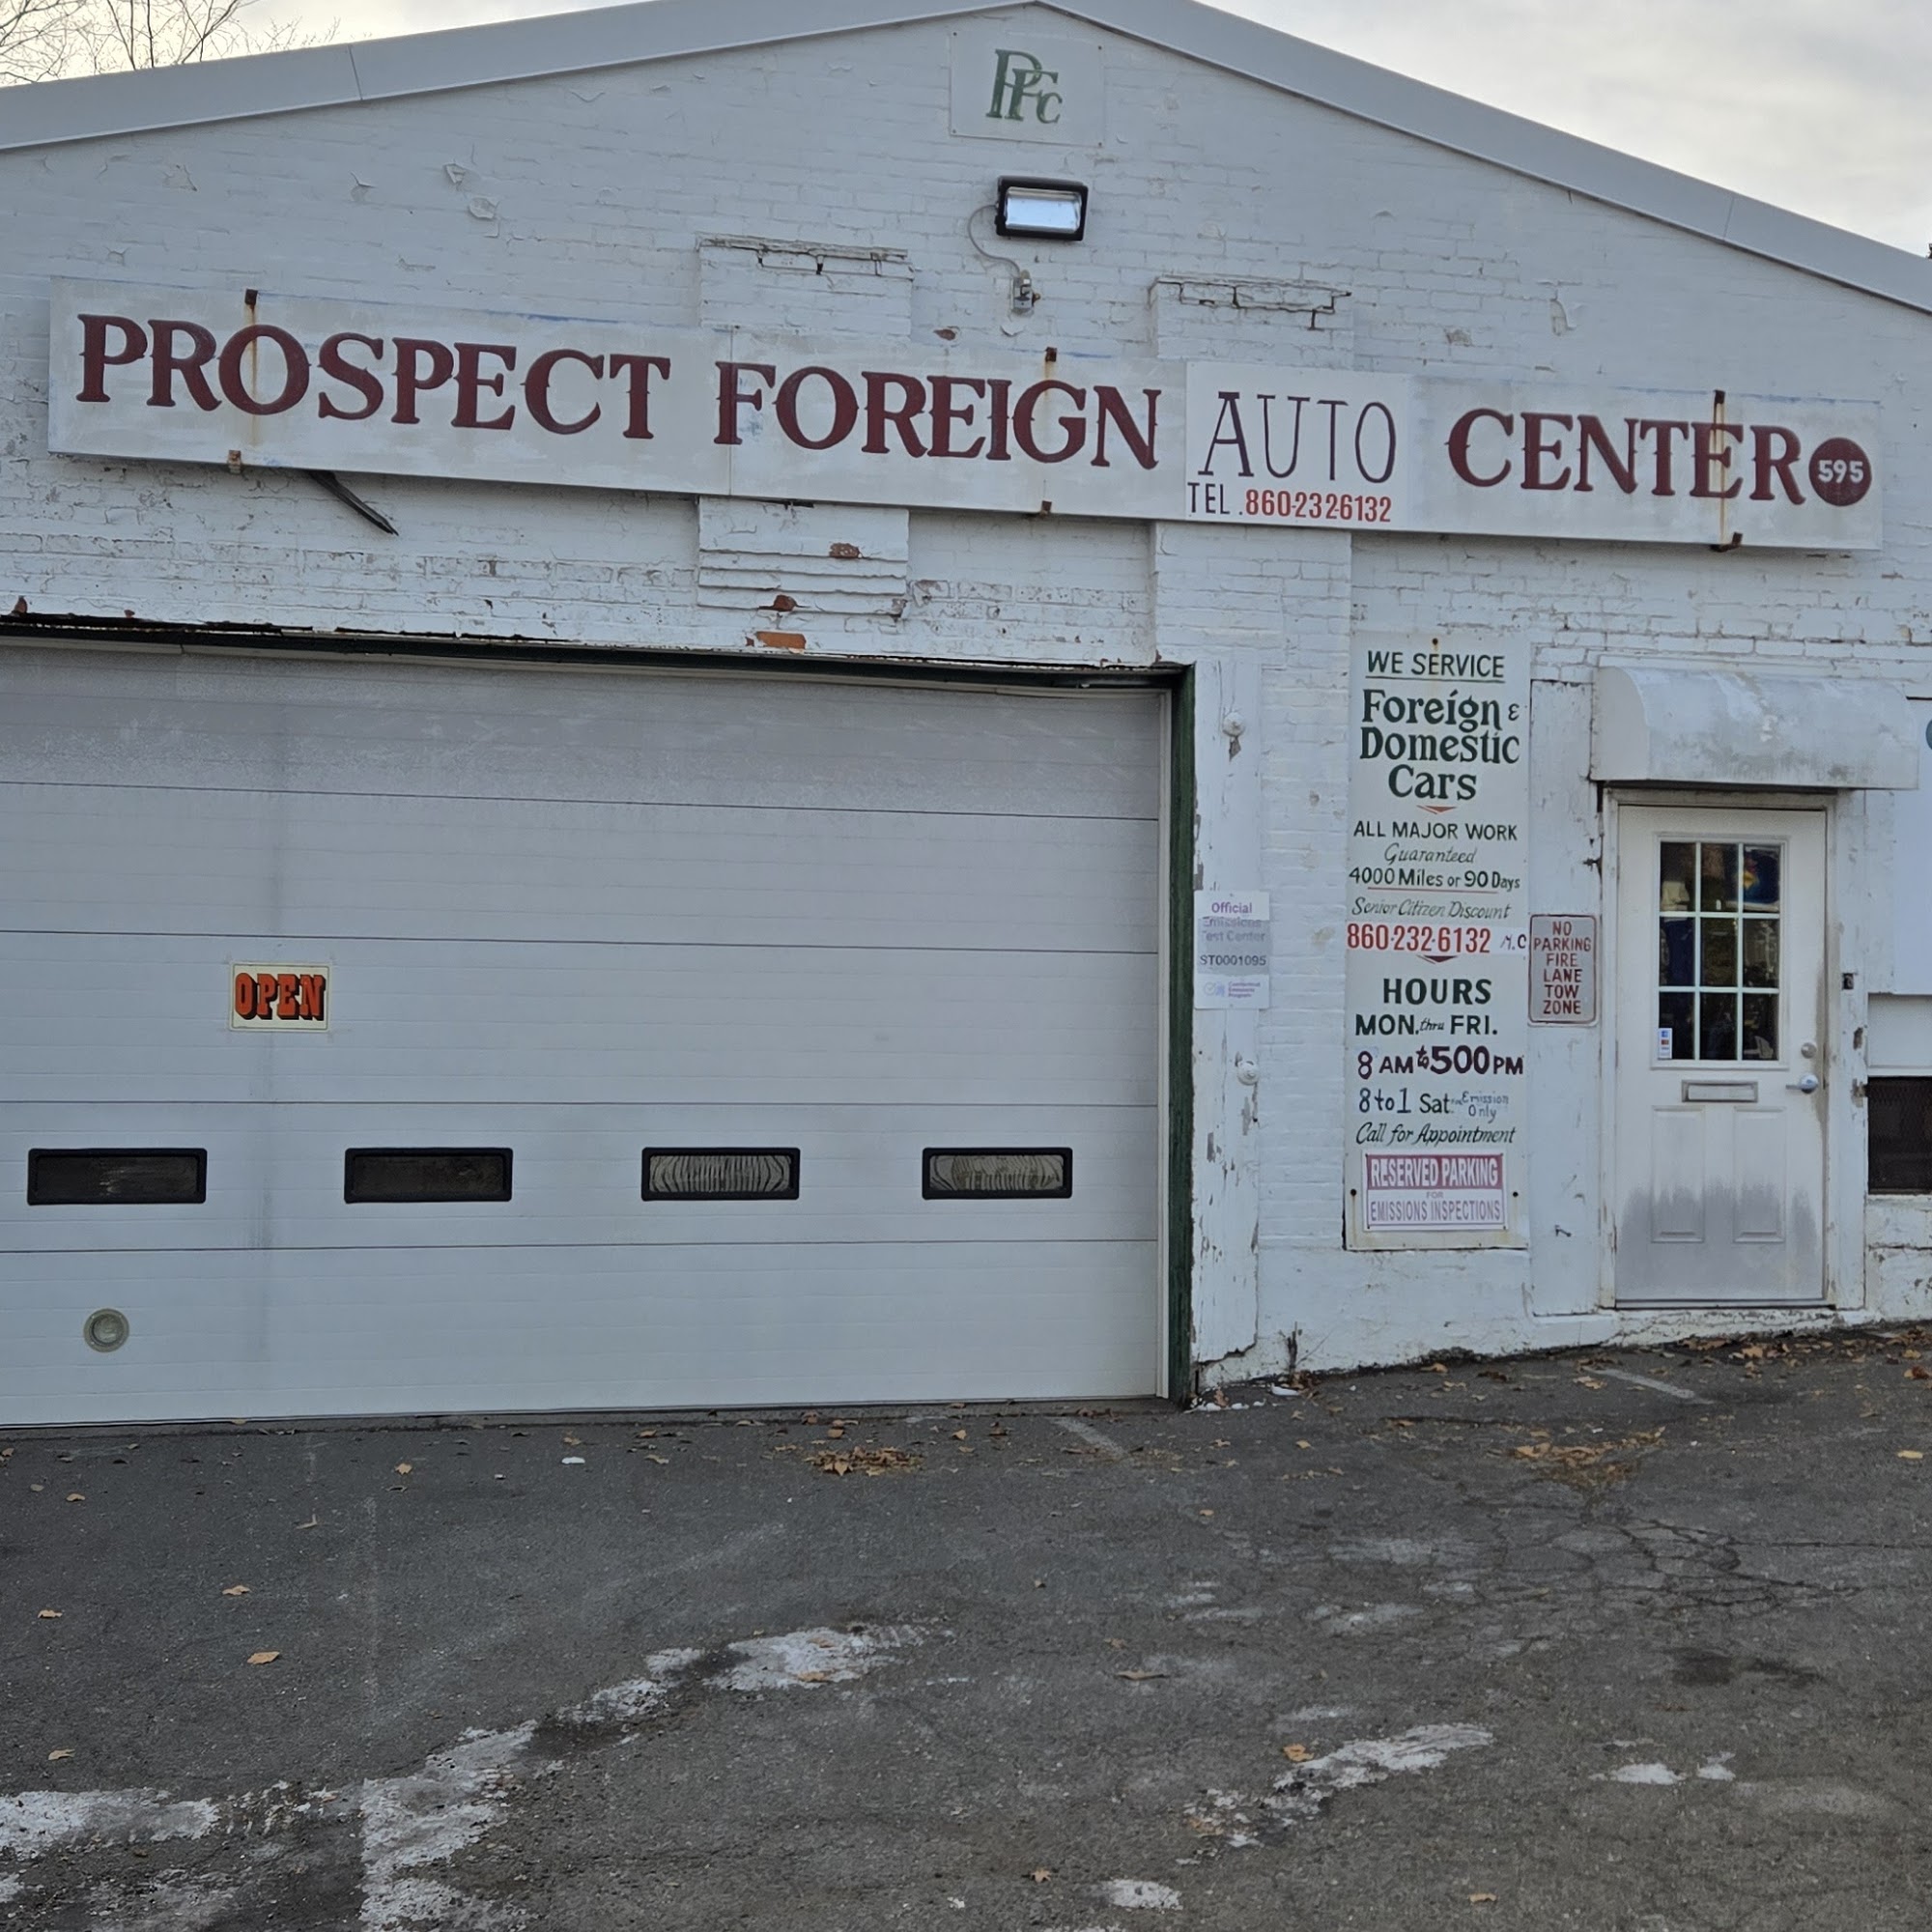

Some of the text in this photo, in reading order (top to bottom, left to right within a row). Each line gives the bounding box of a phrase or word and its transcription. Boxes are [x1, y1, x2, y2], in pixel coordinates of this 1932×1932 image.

[76, 313, 1863, 505] PROSPECT FOREIGN AUTO CENTER 595
[1367, 650, 1505, 678] WE SERVICE
[1362, 689, 1503, 733] Foreign
[1359, 726, 1520, 764] Domestic
[1388, 764, 1477, 801] Cars
[1353, 820, 1518, 841] ALL MAJOR WORK
[1384, 842, 1478, 866] Guaranteed
[1349, 867, 1520, 893] 4000 Miles or 90 Days
[1211, 901, 1253, 914] Official
[1351, 896, 1513, 920] Senior Citizen Discount
[1552, 921, 1573, 937] NO
[1533, 937, 1592, 952] PARKING
[1199, 954, 1267, 966] ST0001095
[1547, 952, 1578, 967] FIRE
[1543, 968, 1583, 983] LANE
[235, 972, 327, 1021] OPEN
[1383, 978, 1492, 1006] HOURS
[1544, 984, 1579, 999] TOW
[1543, 1000, 1581, 1015] ZONE
[1355, 1014, 1498, 1036] MON. thru FRI.
[1357, 1044, 1524, 1080] 8 AM to 500 PM
[1462, 1091, 1509, 1104] Emission
[1468, 1104, 1497, 1123] Only
[1355, 1122, 1517, 1148] Call for Appointment
[1370, 1158, 1498, 1187] RESERVED PARKING
[1426, 1191, 1444, 1200] FOR
[1370, 1200, 1501, 1222] EMISSIONS INSPECTIONS
